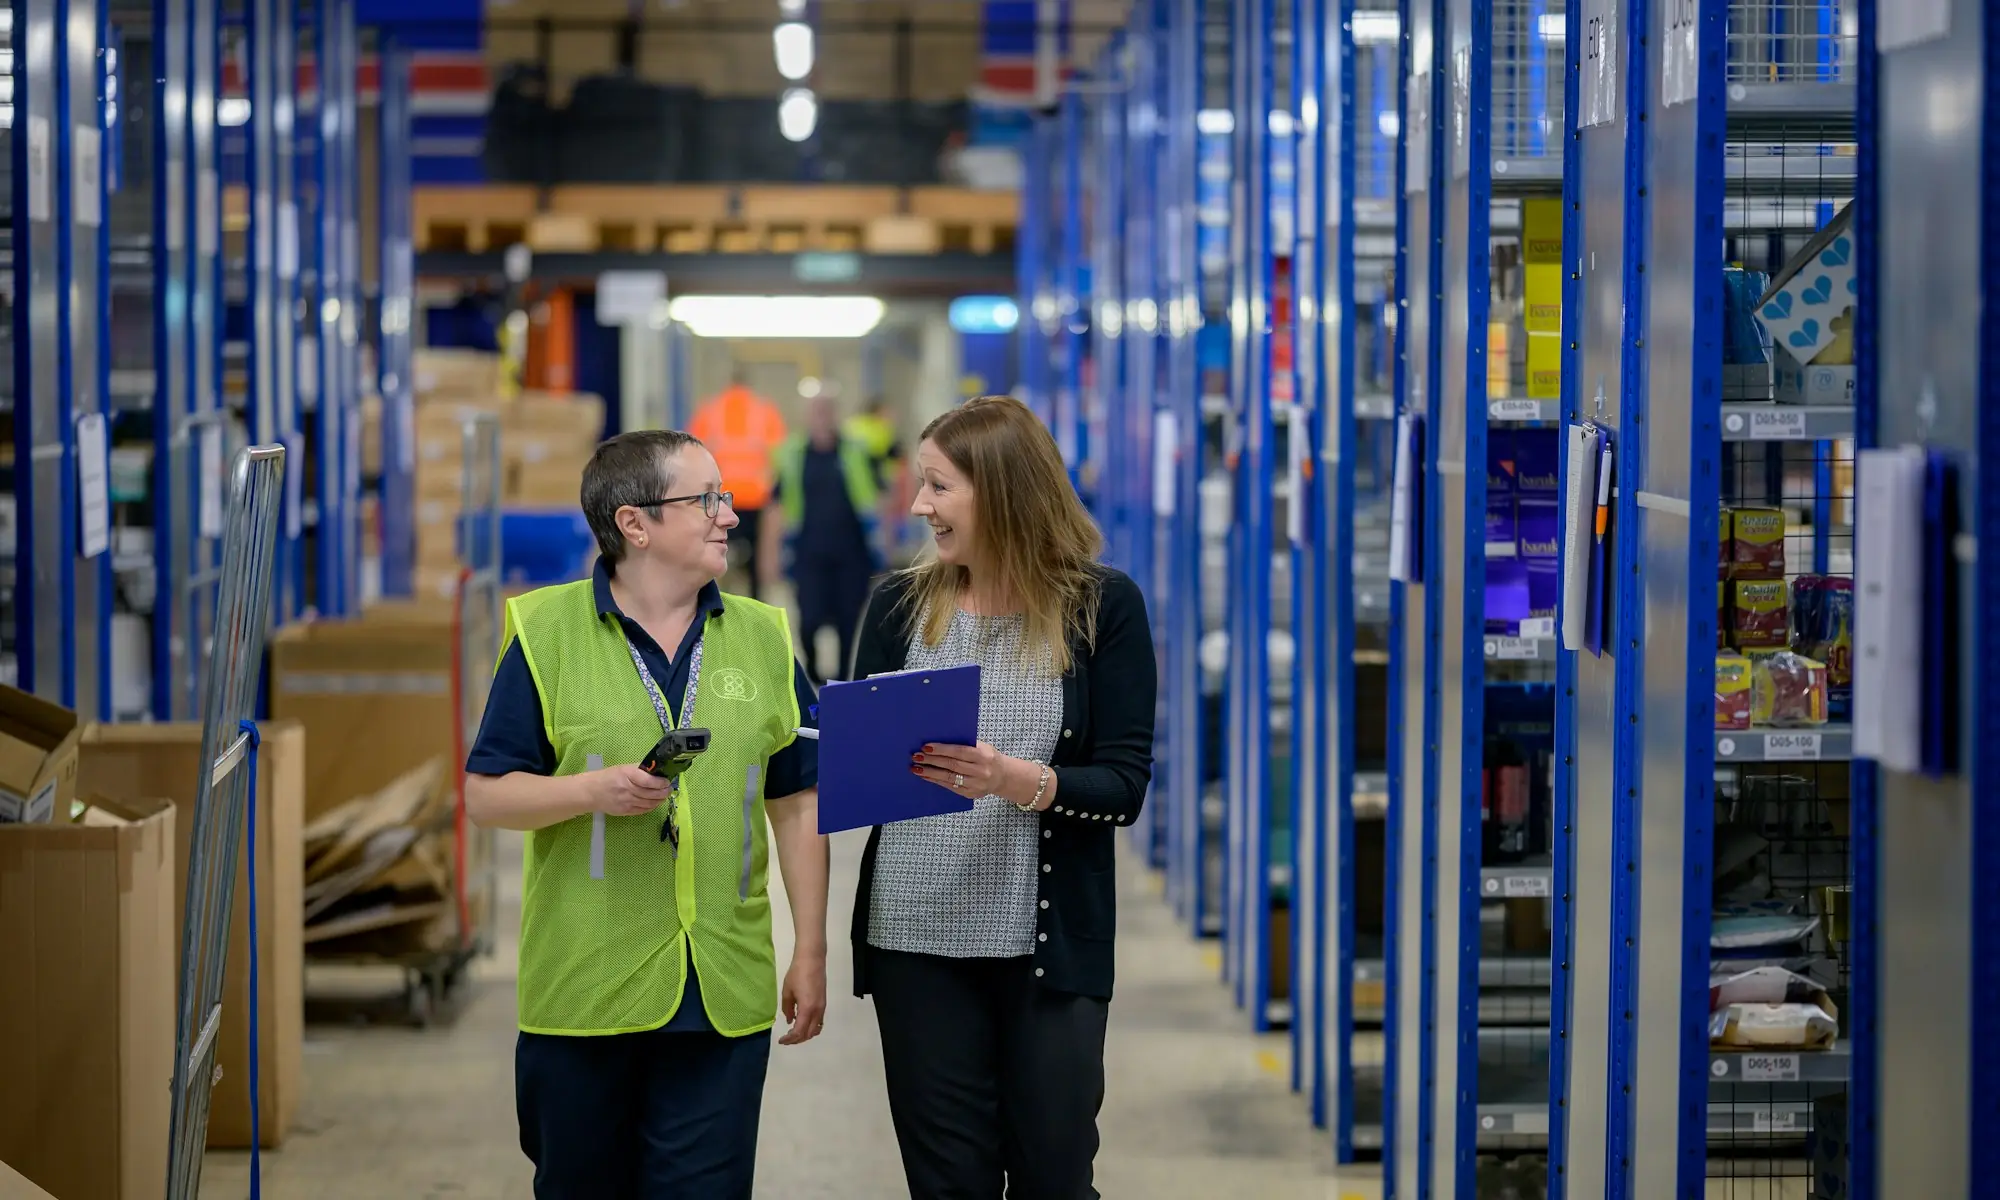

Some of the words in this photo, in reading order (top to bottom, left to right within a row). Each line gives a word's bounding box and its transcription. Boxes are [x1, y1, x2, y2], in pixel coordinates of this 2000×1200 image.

[1755, 412, 1799, 426] D05-050
[1741, 515, 1780, 527] Anadin
[1742, 583, 1781, 595] Anadin
[1769, 735, 1814, 748] D05-100
[1748, 1057, 1792, 1070] D05-150
